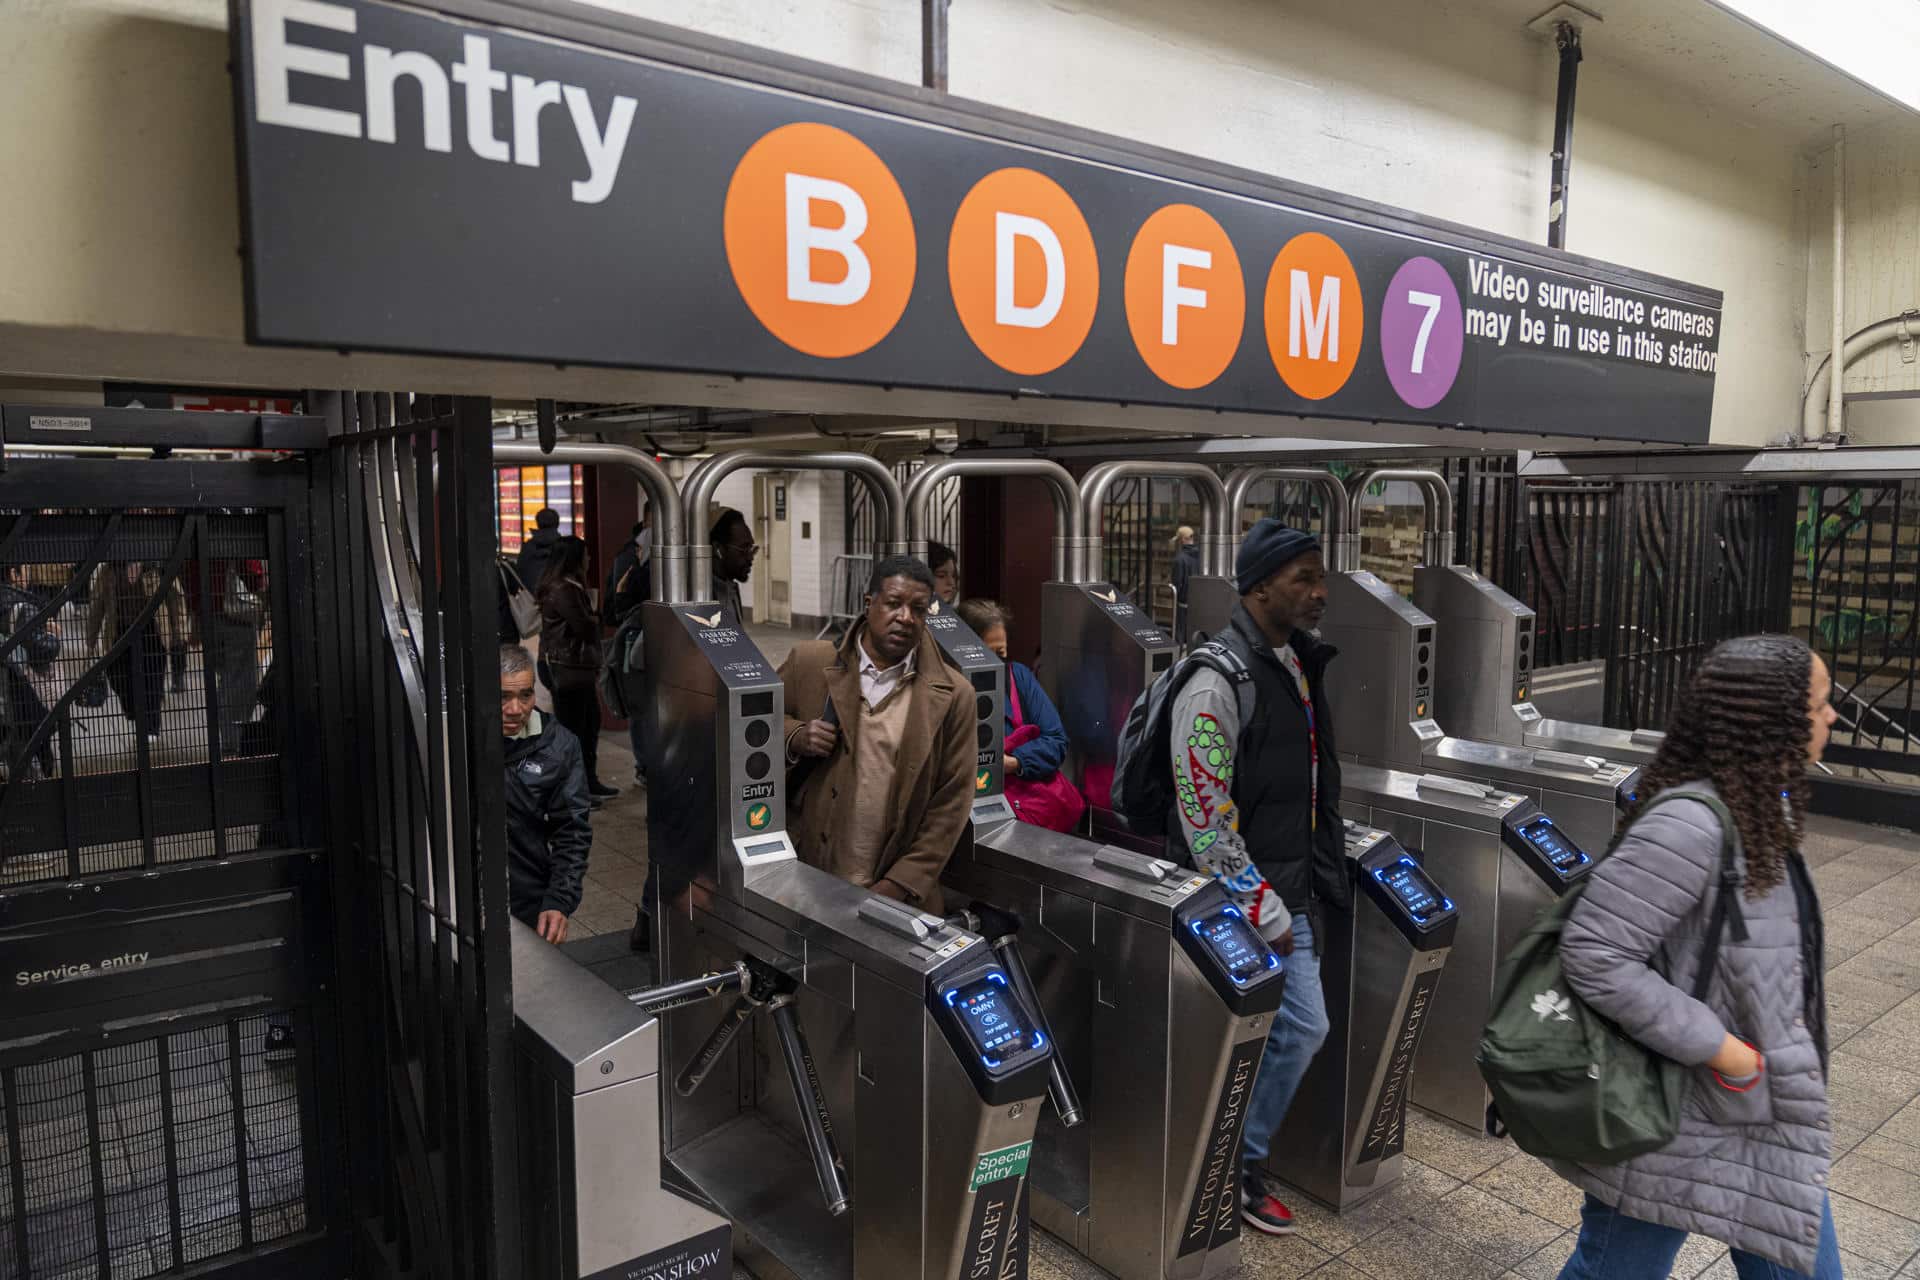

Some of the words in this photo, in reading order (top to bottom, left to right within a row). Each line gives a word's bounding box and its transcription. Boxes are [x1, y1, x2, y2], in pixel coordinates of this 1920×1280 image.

[250, 0, 638, 204] Entry
[784, 172, 872, 307] B
[995, 210, 1066, 329] D
[1161, 243, 1212, 346] F
[1288, 268, 1341, 363] M
[1407, 290, 1442, 374] 7
[1468, 258, 1529, 304] Video
[1537, 281, 1645, 325] surveillance
[1651, 304, 1714, 338] cameras
[1466, 307, 1512, 347] may
[1519, 308, 1546, 345] be
[1553, 315, 1570, 349] in
[1578, 325, 1610, 354] use
[1616, 326, 1631, 358] in
[1634, 331, 1663, 364] this
[1668, 340, 1719, 373] station
[743, 784, 773, 798] Entry
[16, 963, 92, 986] Service
[101, 952, 149, 970] entry
[970, 999, 996, 1016] OMNY
[1400, 986, 1429, 1051] SECRET
[1220, 1059, 1252, 1129] SECRET
[975, 1164, 1013, 1184] entry
[978, 1144, 1031, 1171] Special
[669, 1248, 721, 1280] SHOW
[970, 1200, 1004, 1279] SECRET
